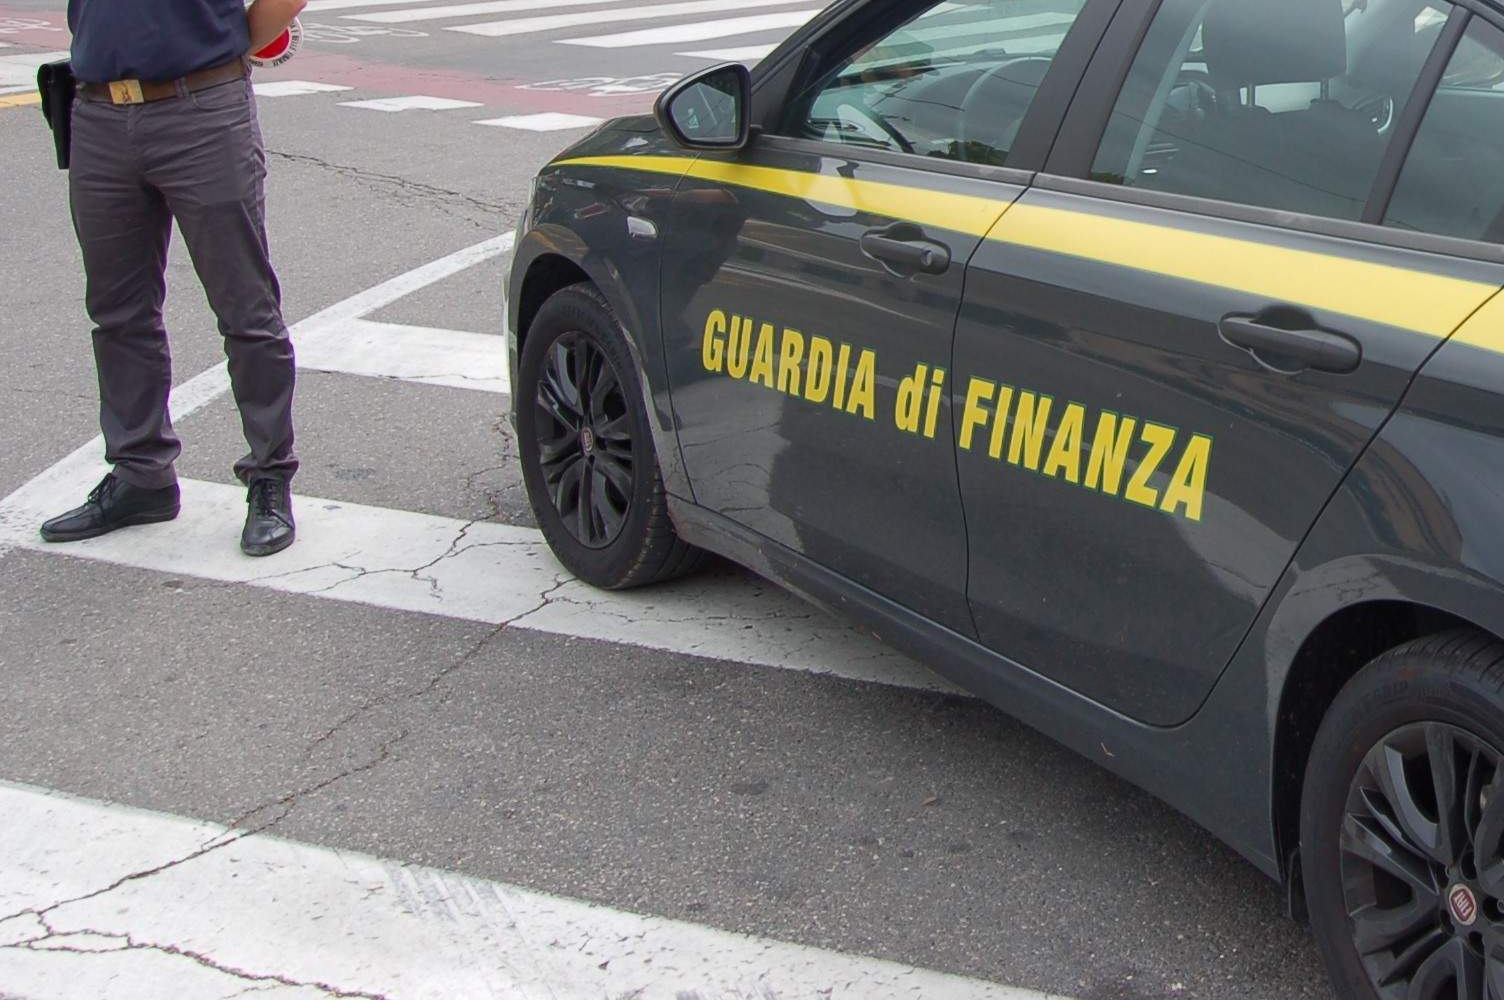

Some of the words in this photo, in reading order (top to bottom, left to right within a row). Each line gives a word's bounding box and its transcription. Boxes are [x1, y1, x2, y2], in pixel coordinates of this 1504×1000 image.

[701, 308, 877, 421] GUARDIA
[894, 361, 946, 439] di
[958, 376, 1213, 522] FINANZA
